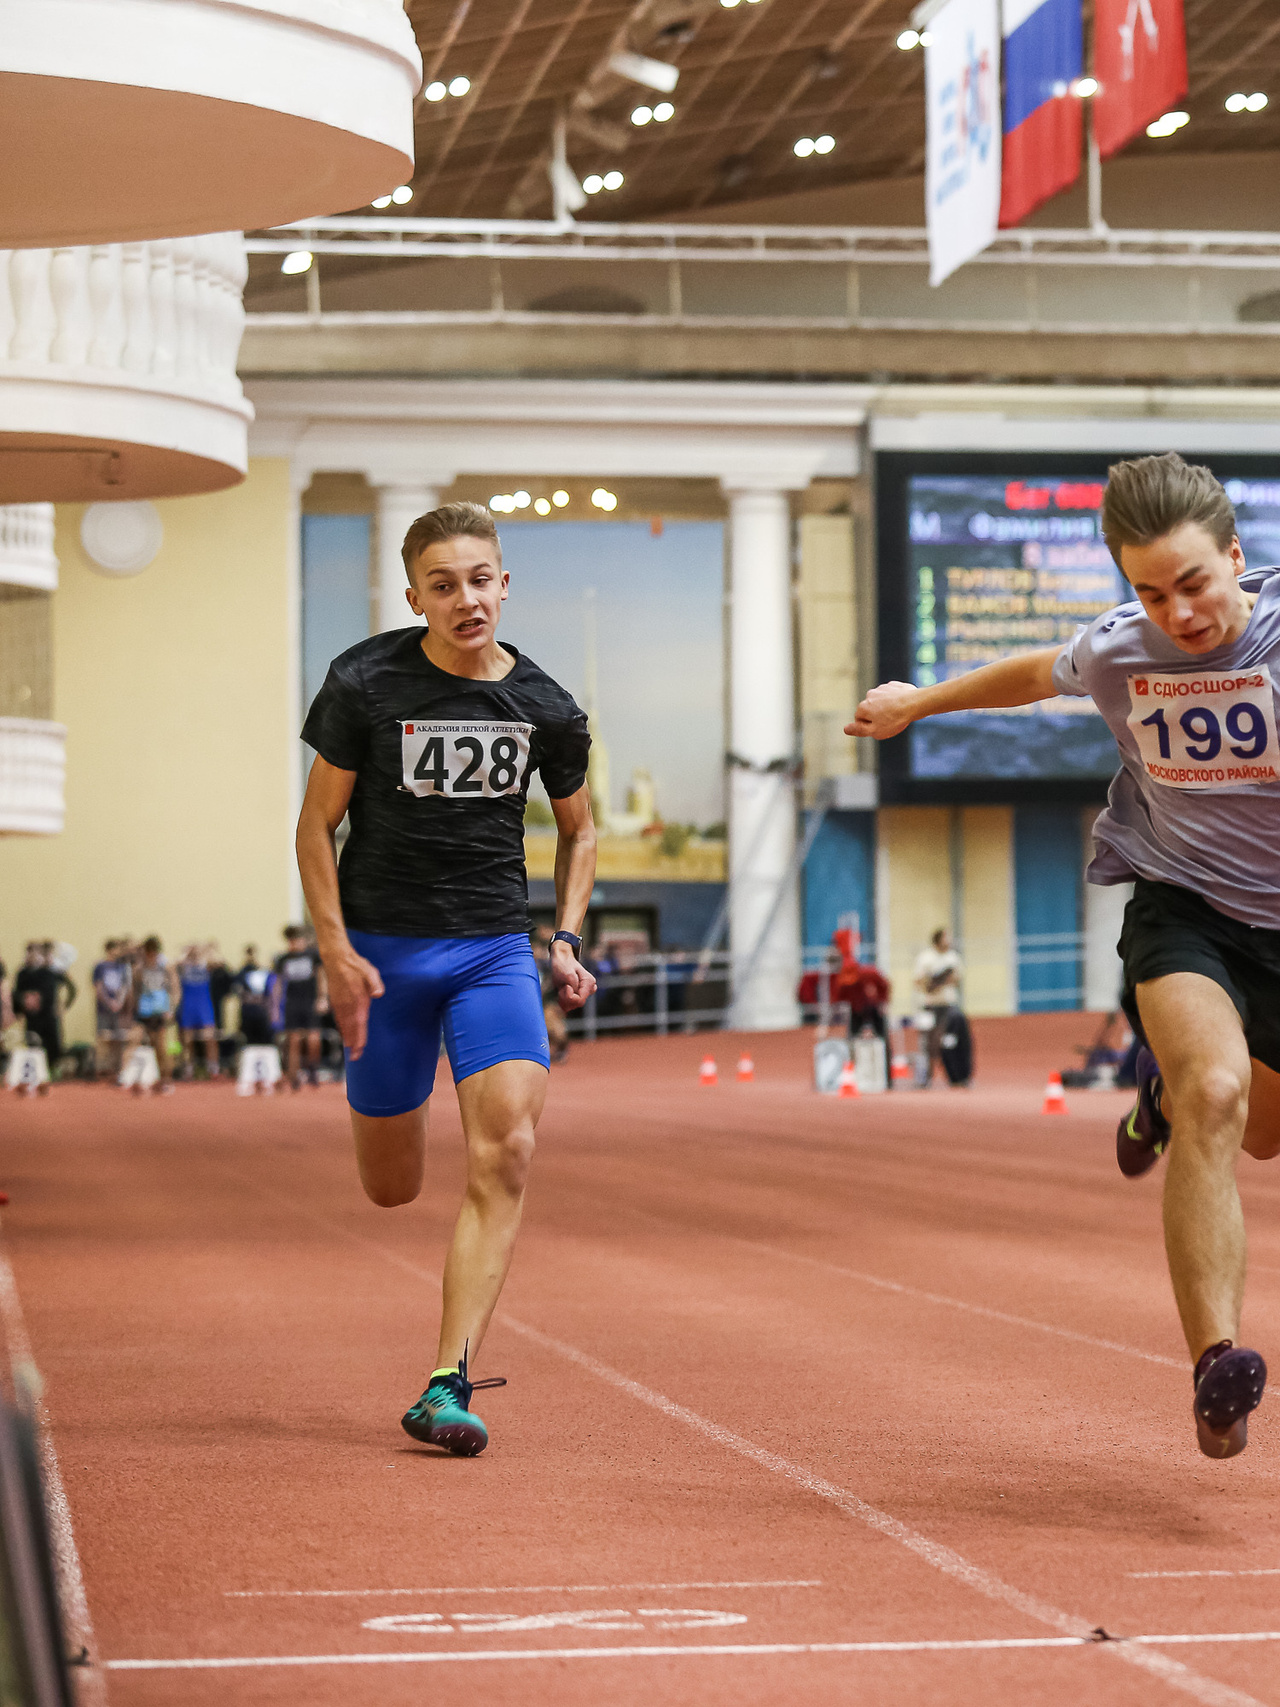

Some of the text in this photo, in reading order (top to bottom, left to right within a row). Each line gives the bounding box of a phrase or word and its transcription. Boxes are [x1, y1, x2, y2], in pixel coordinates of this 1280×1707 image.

[1153, 675, 1265, 698] СДЮСШОР-2
[416, 725, 460, 733] АКАДЕМИЯ
[461, 724, 490, 733] ЛЕГКОЙ
[1141, 702, 1268, 762] 199
[413, 736, 519, 793] 428
[1228, 765, 1276, 780] РАЙОНА
